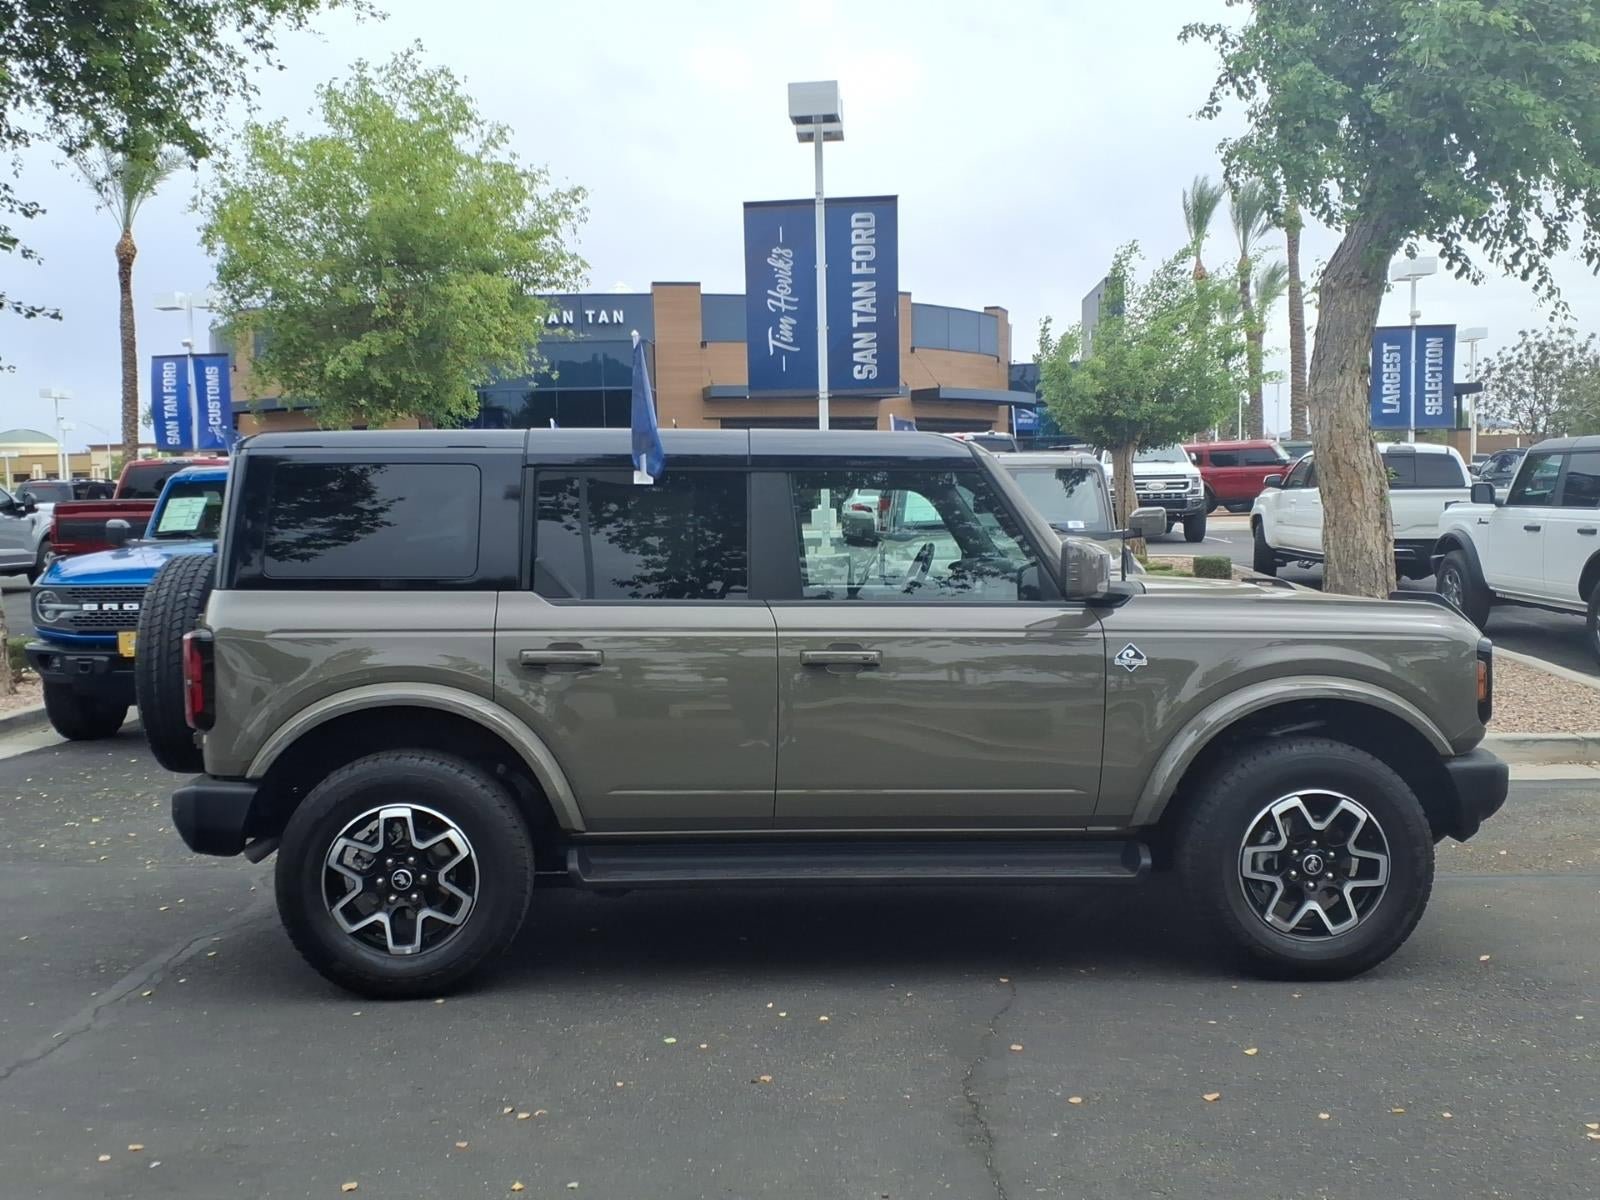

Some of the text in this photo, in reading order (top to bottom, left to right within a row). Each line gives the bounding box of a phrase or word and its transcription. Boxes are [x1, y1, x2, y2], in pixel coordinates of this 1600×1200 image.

[585, 310, 624, 324] TAN
[767, 246, 800, 356] Tim Hovik's
[851, 212, 877, 380] SAN TAN FORD
[162, 362, 181, 445] SAN TAN FORD
[205, 366, 222, 425] CUSTOMS
[1382, 342, 1401, 414] LARGEST
[1425, 337, 1443, 416] SELECTION
[82, 603, 139, 611] BRO
